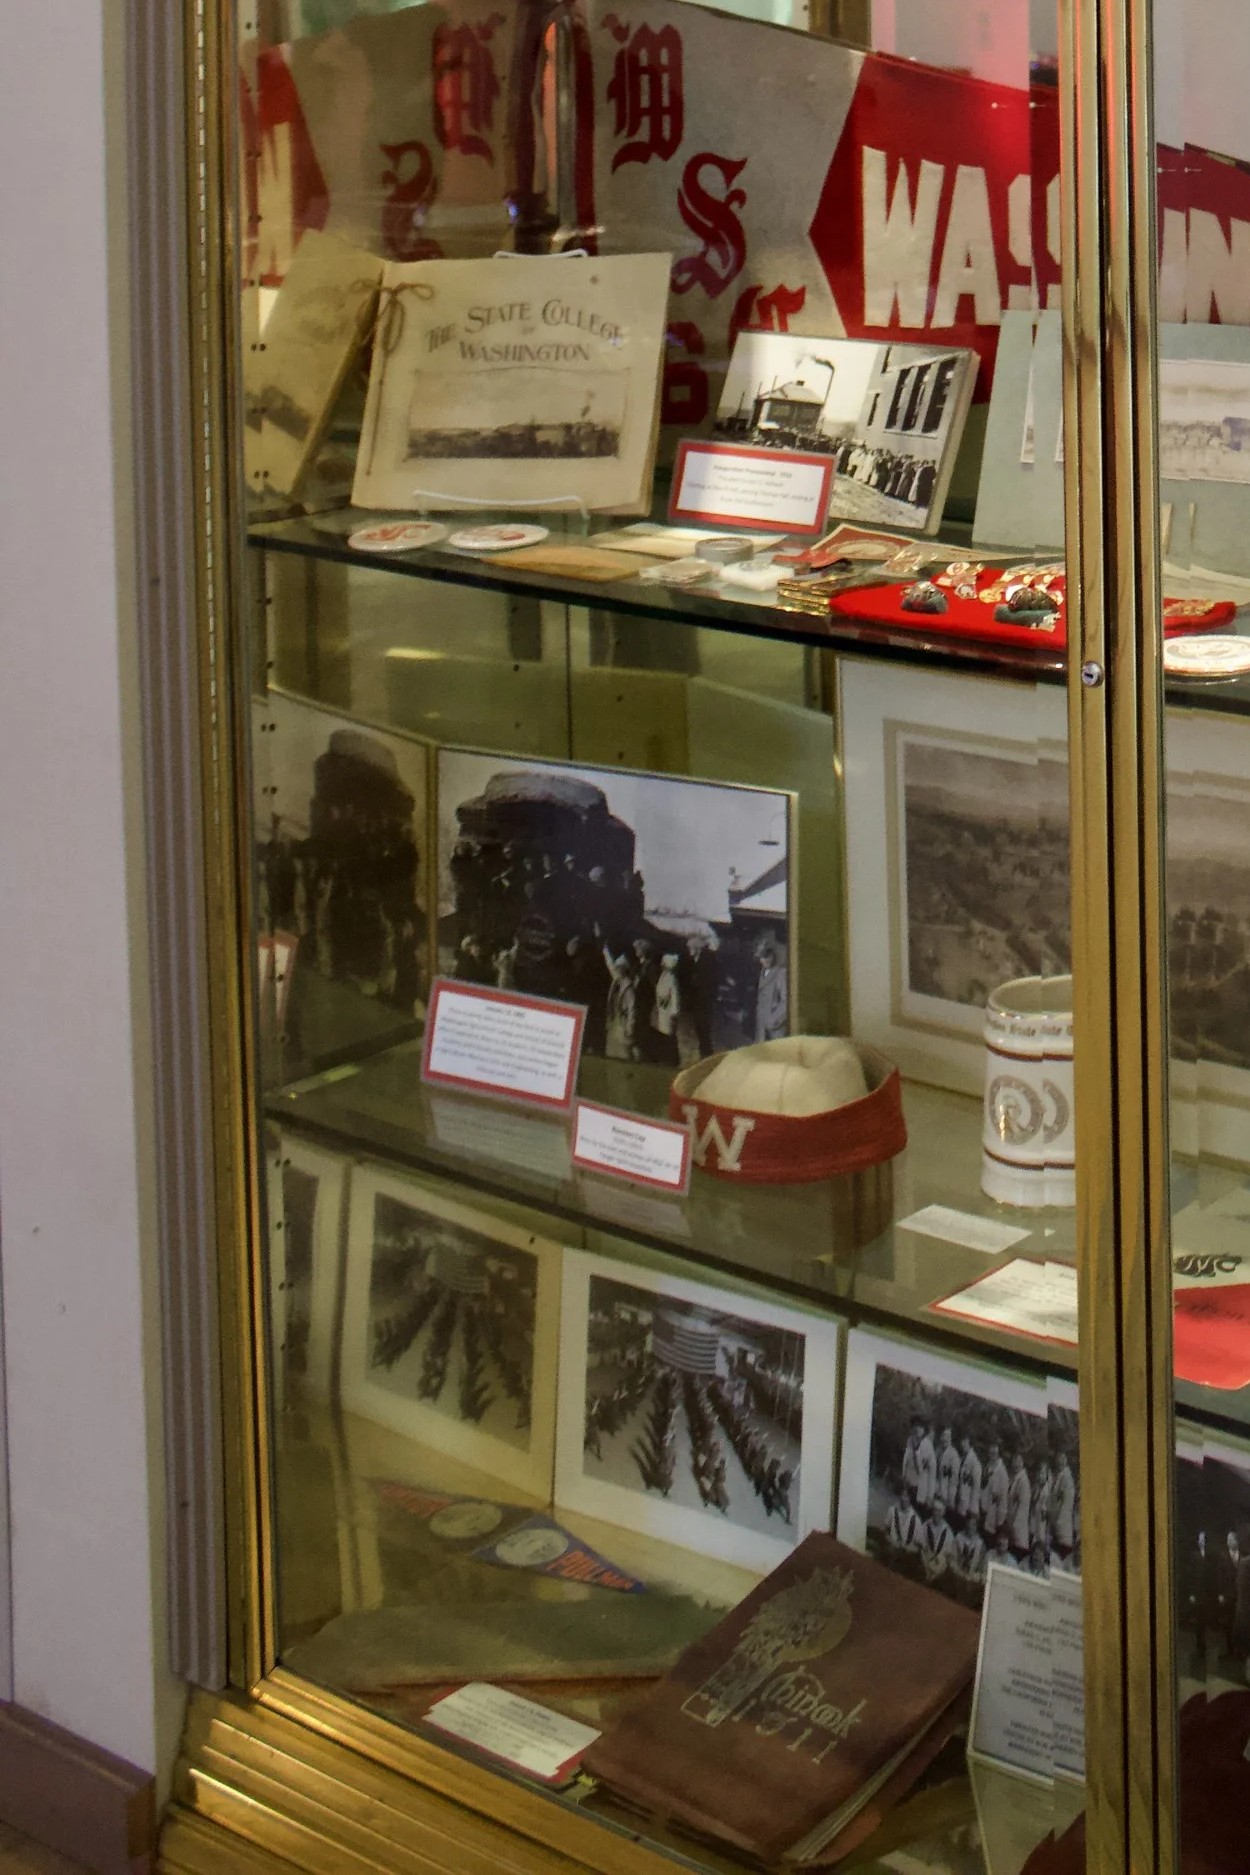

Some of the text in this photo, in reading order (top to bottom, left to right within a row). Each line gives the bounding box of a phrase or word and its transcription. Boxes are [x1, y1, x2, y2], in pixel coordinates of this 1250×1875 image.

[425, 298, 624, 353] THE STATE COLLEGE
[458, 340, 592, 363] WASHINGTON
[688, 1102, 756, 1171] W
